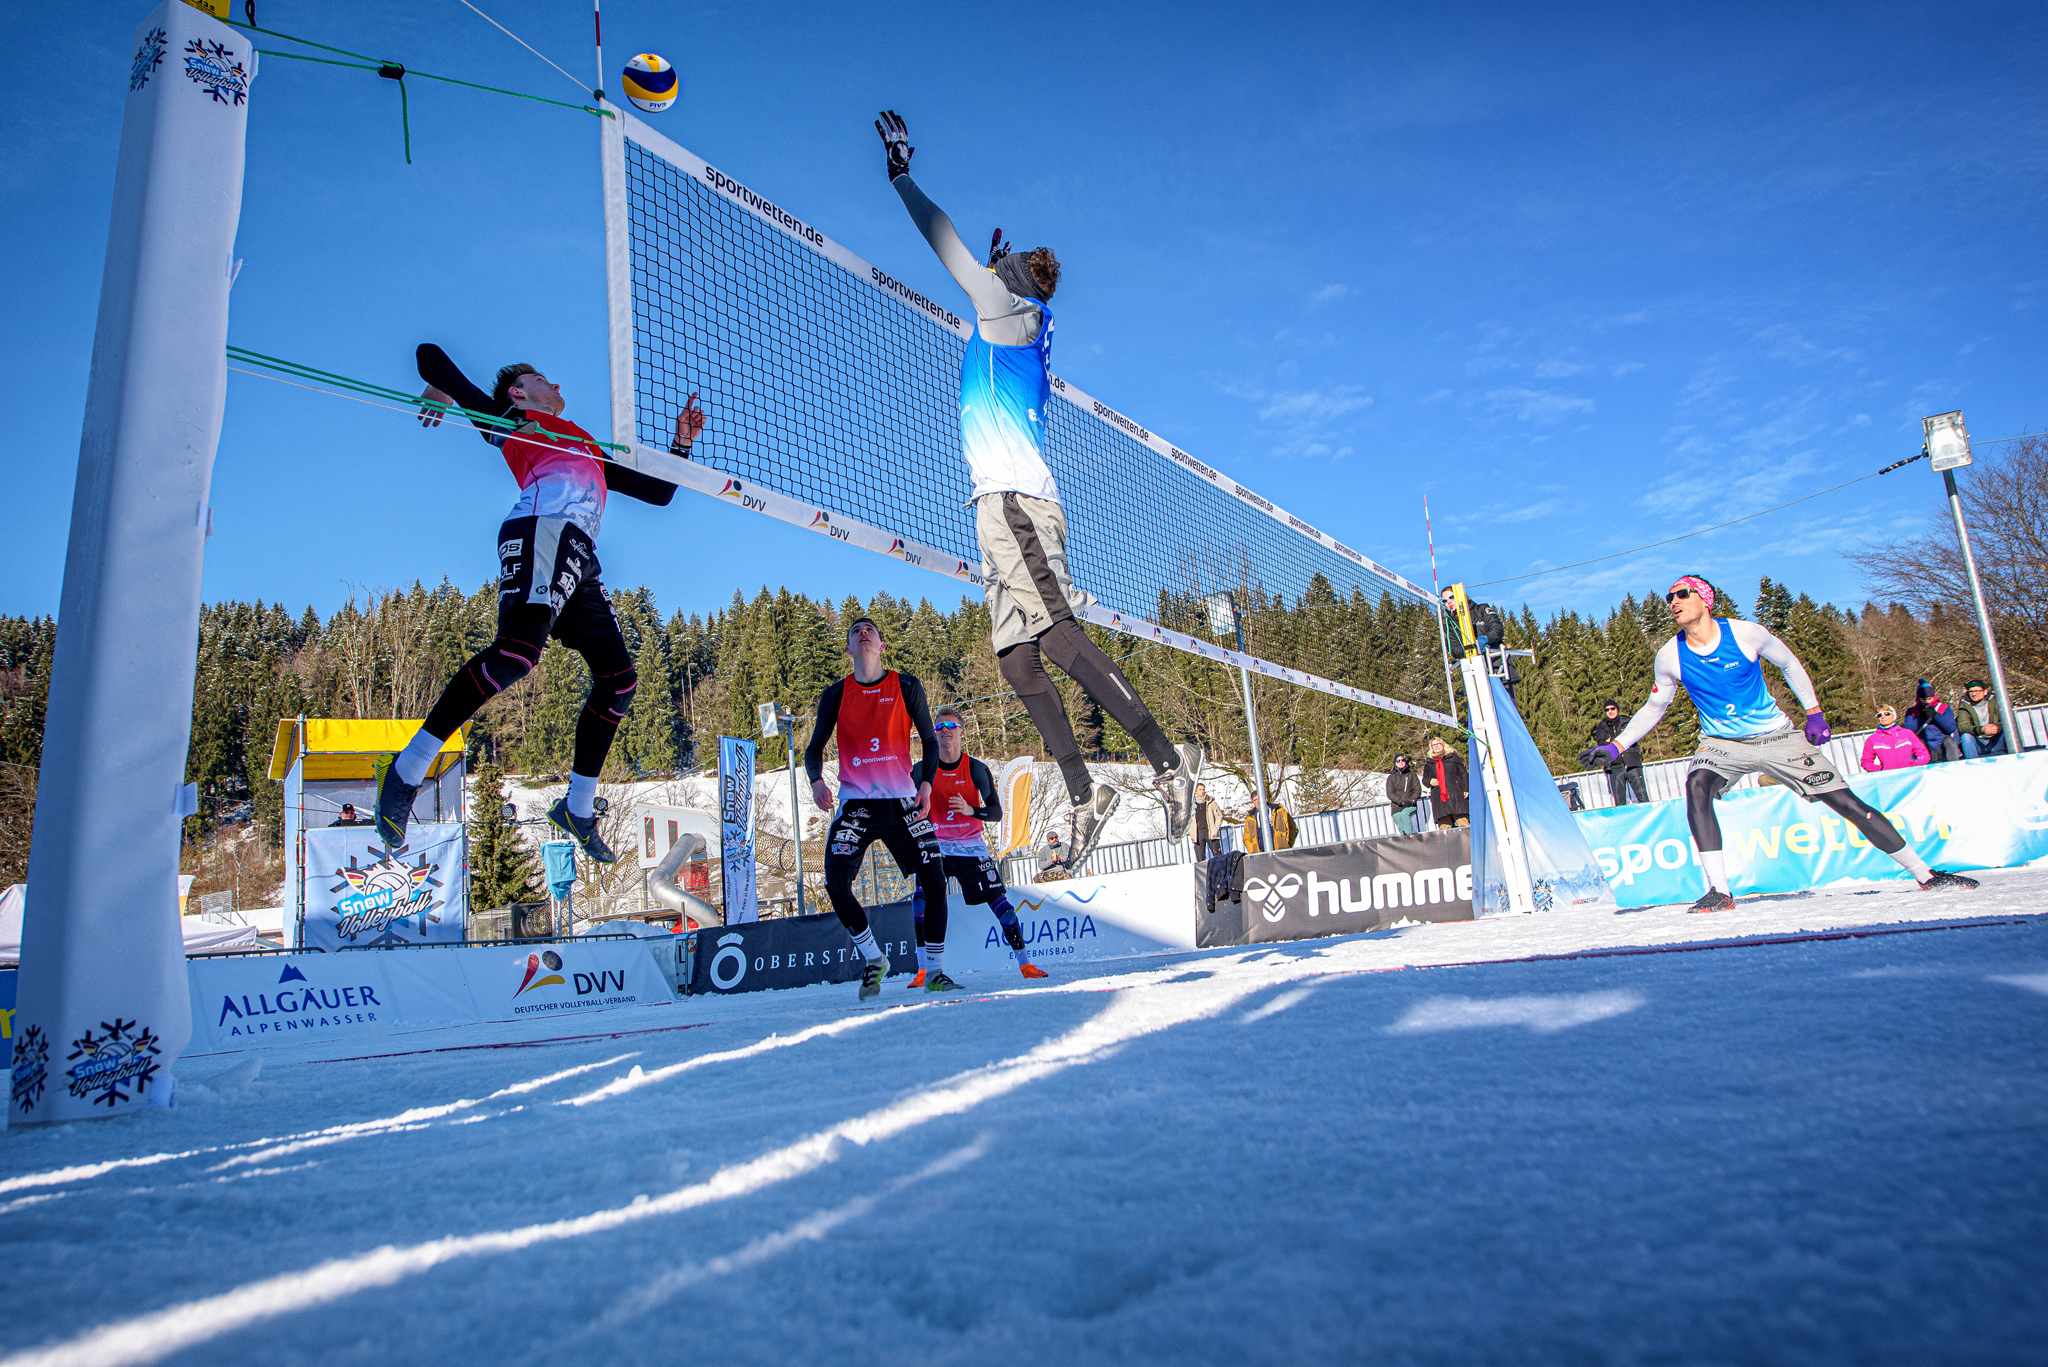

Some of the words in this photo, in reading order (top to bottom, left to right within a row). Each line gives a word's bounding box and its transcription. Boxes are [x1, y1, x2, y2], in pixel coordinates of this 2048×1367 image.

[190, 58, 220, 76] Snow
[186, 67, 243, 92] Volleyball
[705, 166, 824, 247] sportwetten.de
[870, 266, 961, 330] sportwetten.de
[1093, 401, 1149, 442] sportwetten.de
[1171, 447, 1218, 482] sportwetten.de
[742, 495, 766, 512] DVV
[1235, 484, 1274, 514] sportwetten.de
[829, 525, 850, 541] DVV
[905, 551, 922, 566] DVV
[1121, 623, 1133, 633] DVV
[1162, 635, 1172, 645] DVV
[1725, 704, 1737, 716] 2
[870, 738, 880, 752] 3
[735, 743, 752, 832] Volleyball
[1006, 763, 1027, 788] remember
[723, 778, 735, 821] Snow
[1003, 800, 1011, 813] you
[946, 810, 955, 821] 2
[1001, 826, 1011, 844] enjoy
[921, 850, 930, 864] 2
[978, 881, 984, 891] 1
[1306, 864, 1473, 917] humme
[338, 889, 433, 938] Volleyball
[340, 890, 391, 917] Snow
[754, 940, 918, 971] OBERSTAFE
[1009, 946, 1075, 959] EEBNISBAD
[573, 969, 624, 995] DVV
[219, 985, 381, 1027] ALLGÄUER
[514, 1002, 559, 1014] DEUTSCHER
[560, 995, 636, 1010] VOLLEYBALL-VERBAND
[231, 1012, 378, 1036] ALPENWASSER
[70, 1056, 152, 1096] Volleyball
[75, 1058, 117, 1077] Snow
